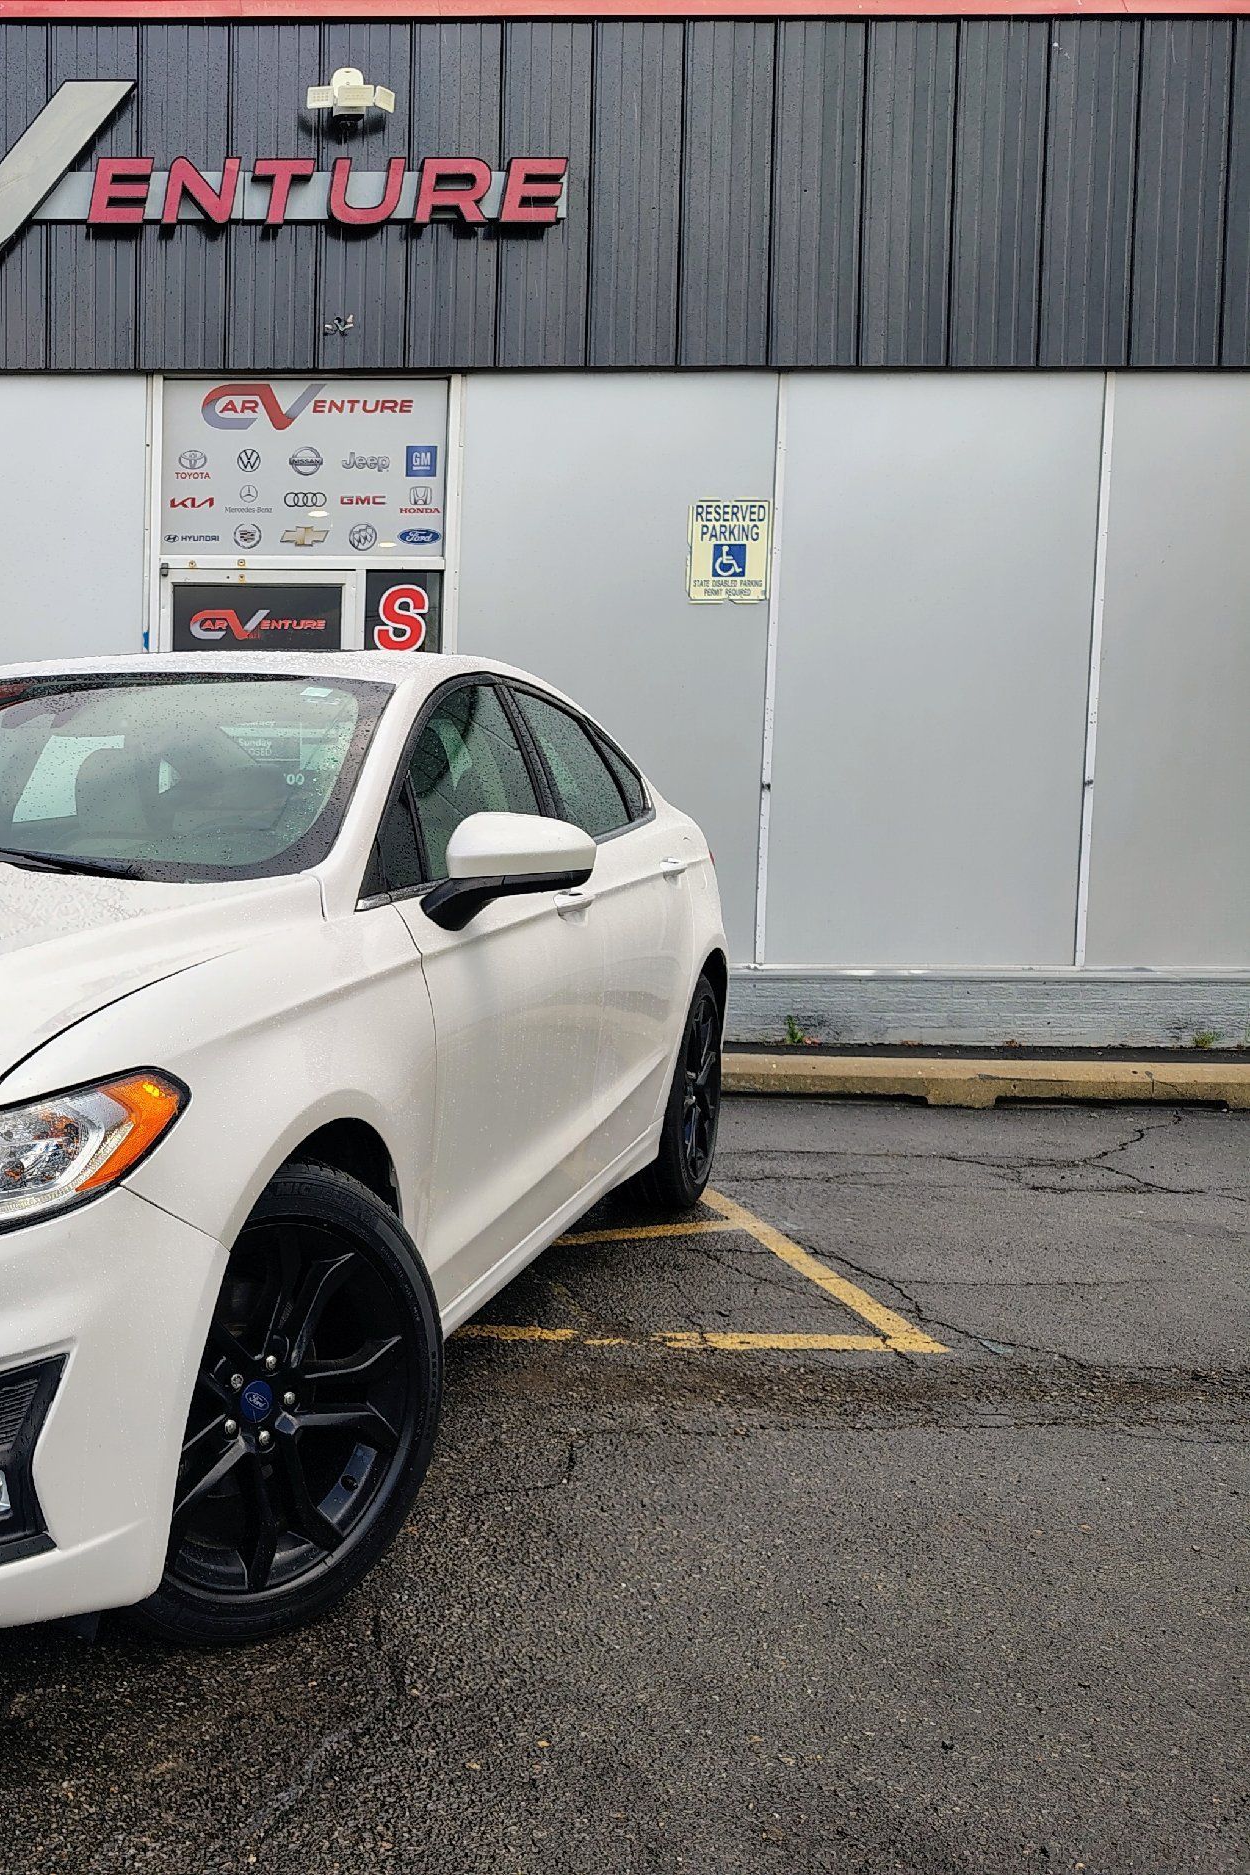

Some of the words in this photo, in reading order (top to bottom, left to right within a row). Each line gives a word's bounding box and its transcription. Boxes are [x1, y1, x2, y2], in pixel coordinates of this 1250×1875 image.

[292, 458, 321, 466] NISSAN
[341, 451, 391, 473] Jeep
[412, 451, 431, 467] GM
[174, 471, 211, 480] TOYOTA
[340, 495, 387, 506] GMC
[224, 506, 273, 515] Mercedes-Benz
[695, 504, 766, 522] RESERVED
[405, 531, 433, 542] Ford
[700, 523, 760, 542] PARKING
[692, 579, 710, 588] STATE
[711, 579, 738, 588] DISABLED
[739, 579, 763, 588] PARKING
[703, 588, 723, 597] PERMIT
[725, 588, 752, 597] REQUIRED
[374, 584, 429, 651] S
[238, 738, 271, 749] Sunday
